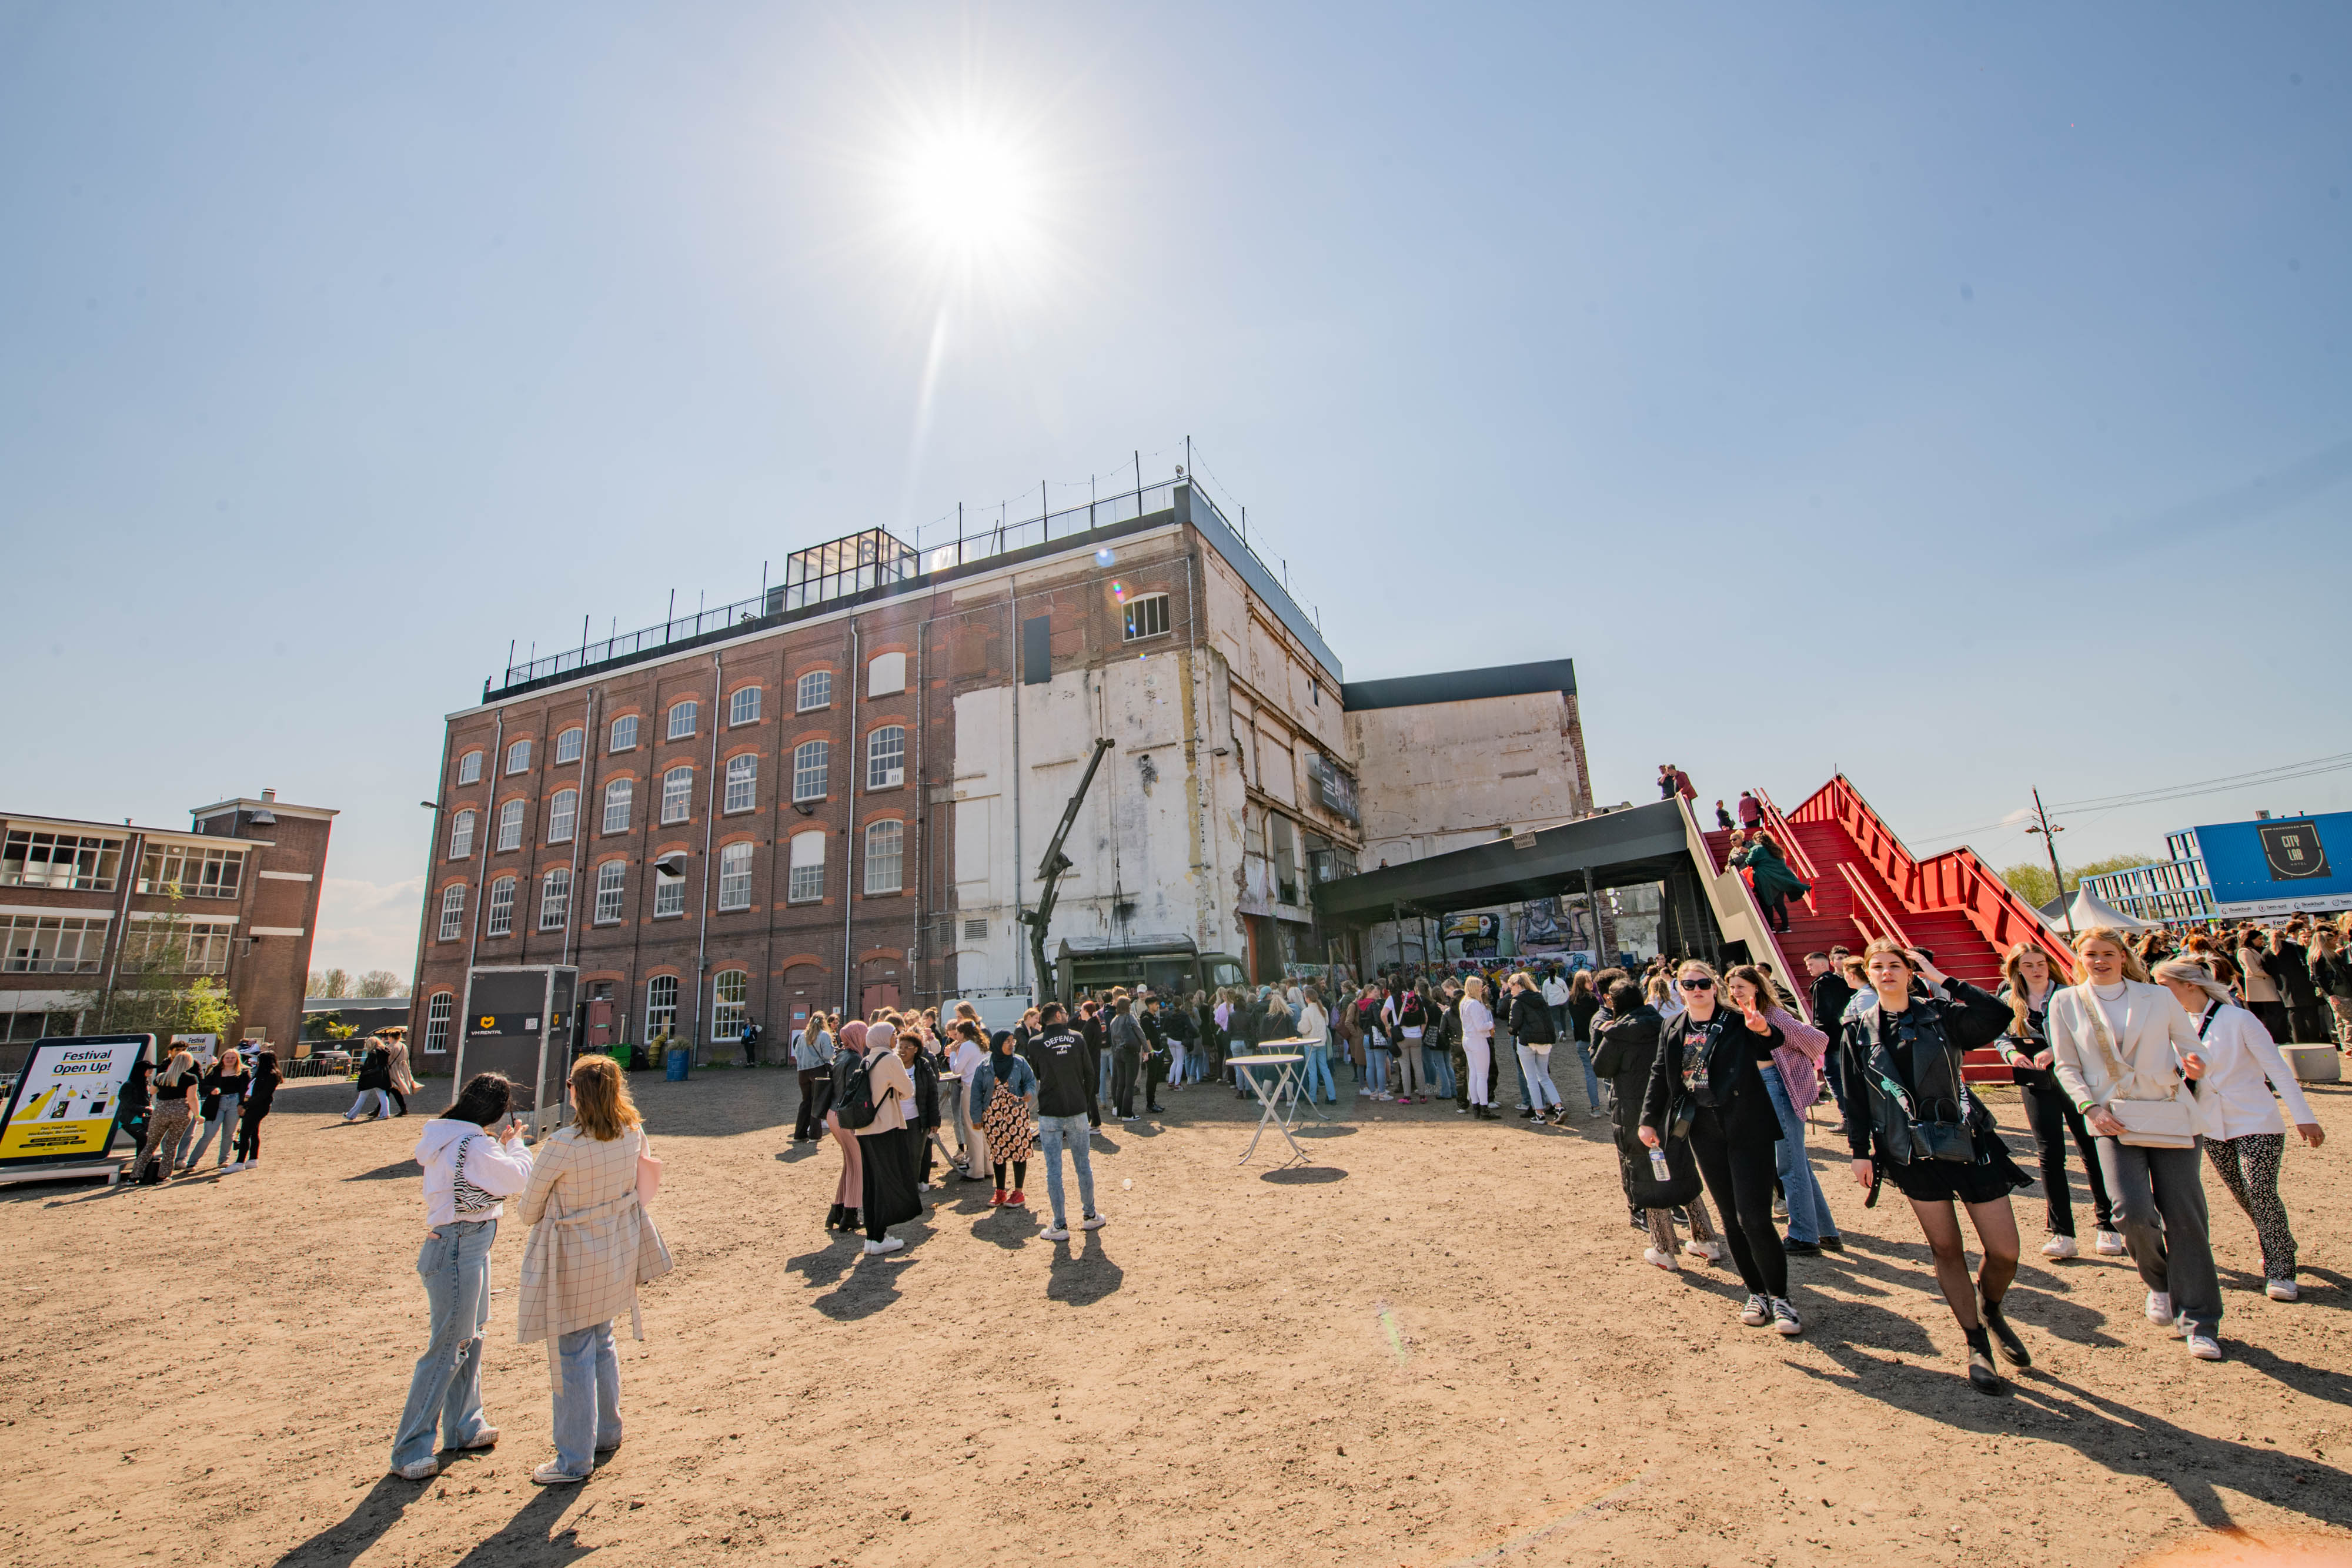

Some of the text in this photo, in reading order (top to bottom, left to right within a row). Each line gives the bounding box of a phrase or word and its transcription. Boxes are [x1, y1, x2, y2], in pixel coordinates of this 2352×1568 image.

[2281, 835, 2300, 847] CITY
[2287, 848, 2304, 861] LAB
[1044, 1035, 1075, 1047] DEFEND
[63, 1049, 112, 1061] Festival
[54, 1062, 112, 1075] Open Up!
